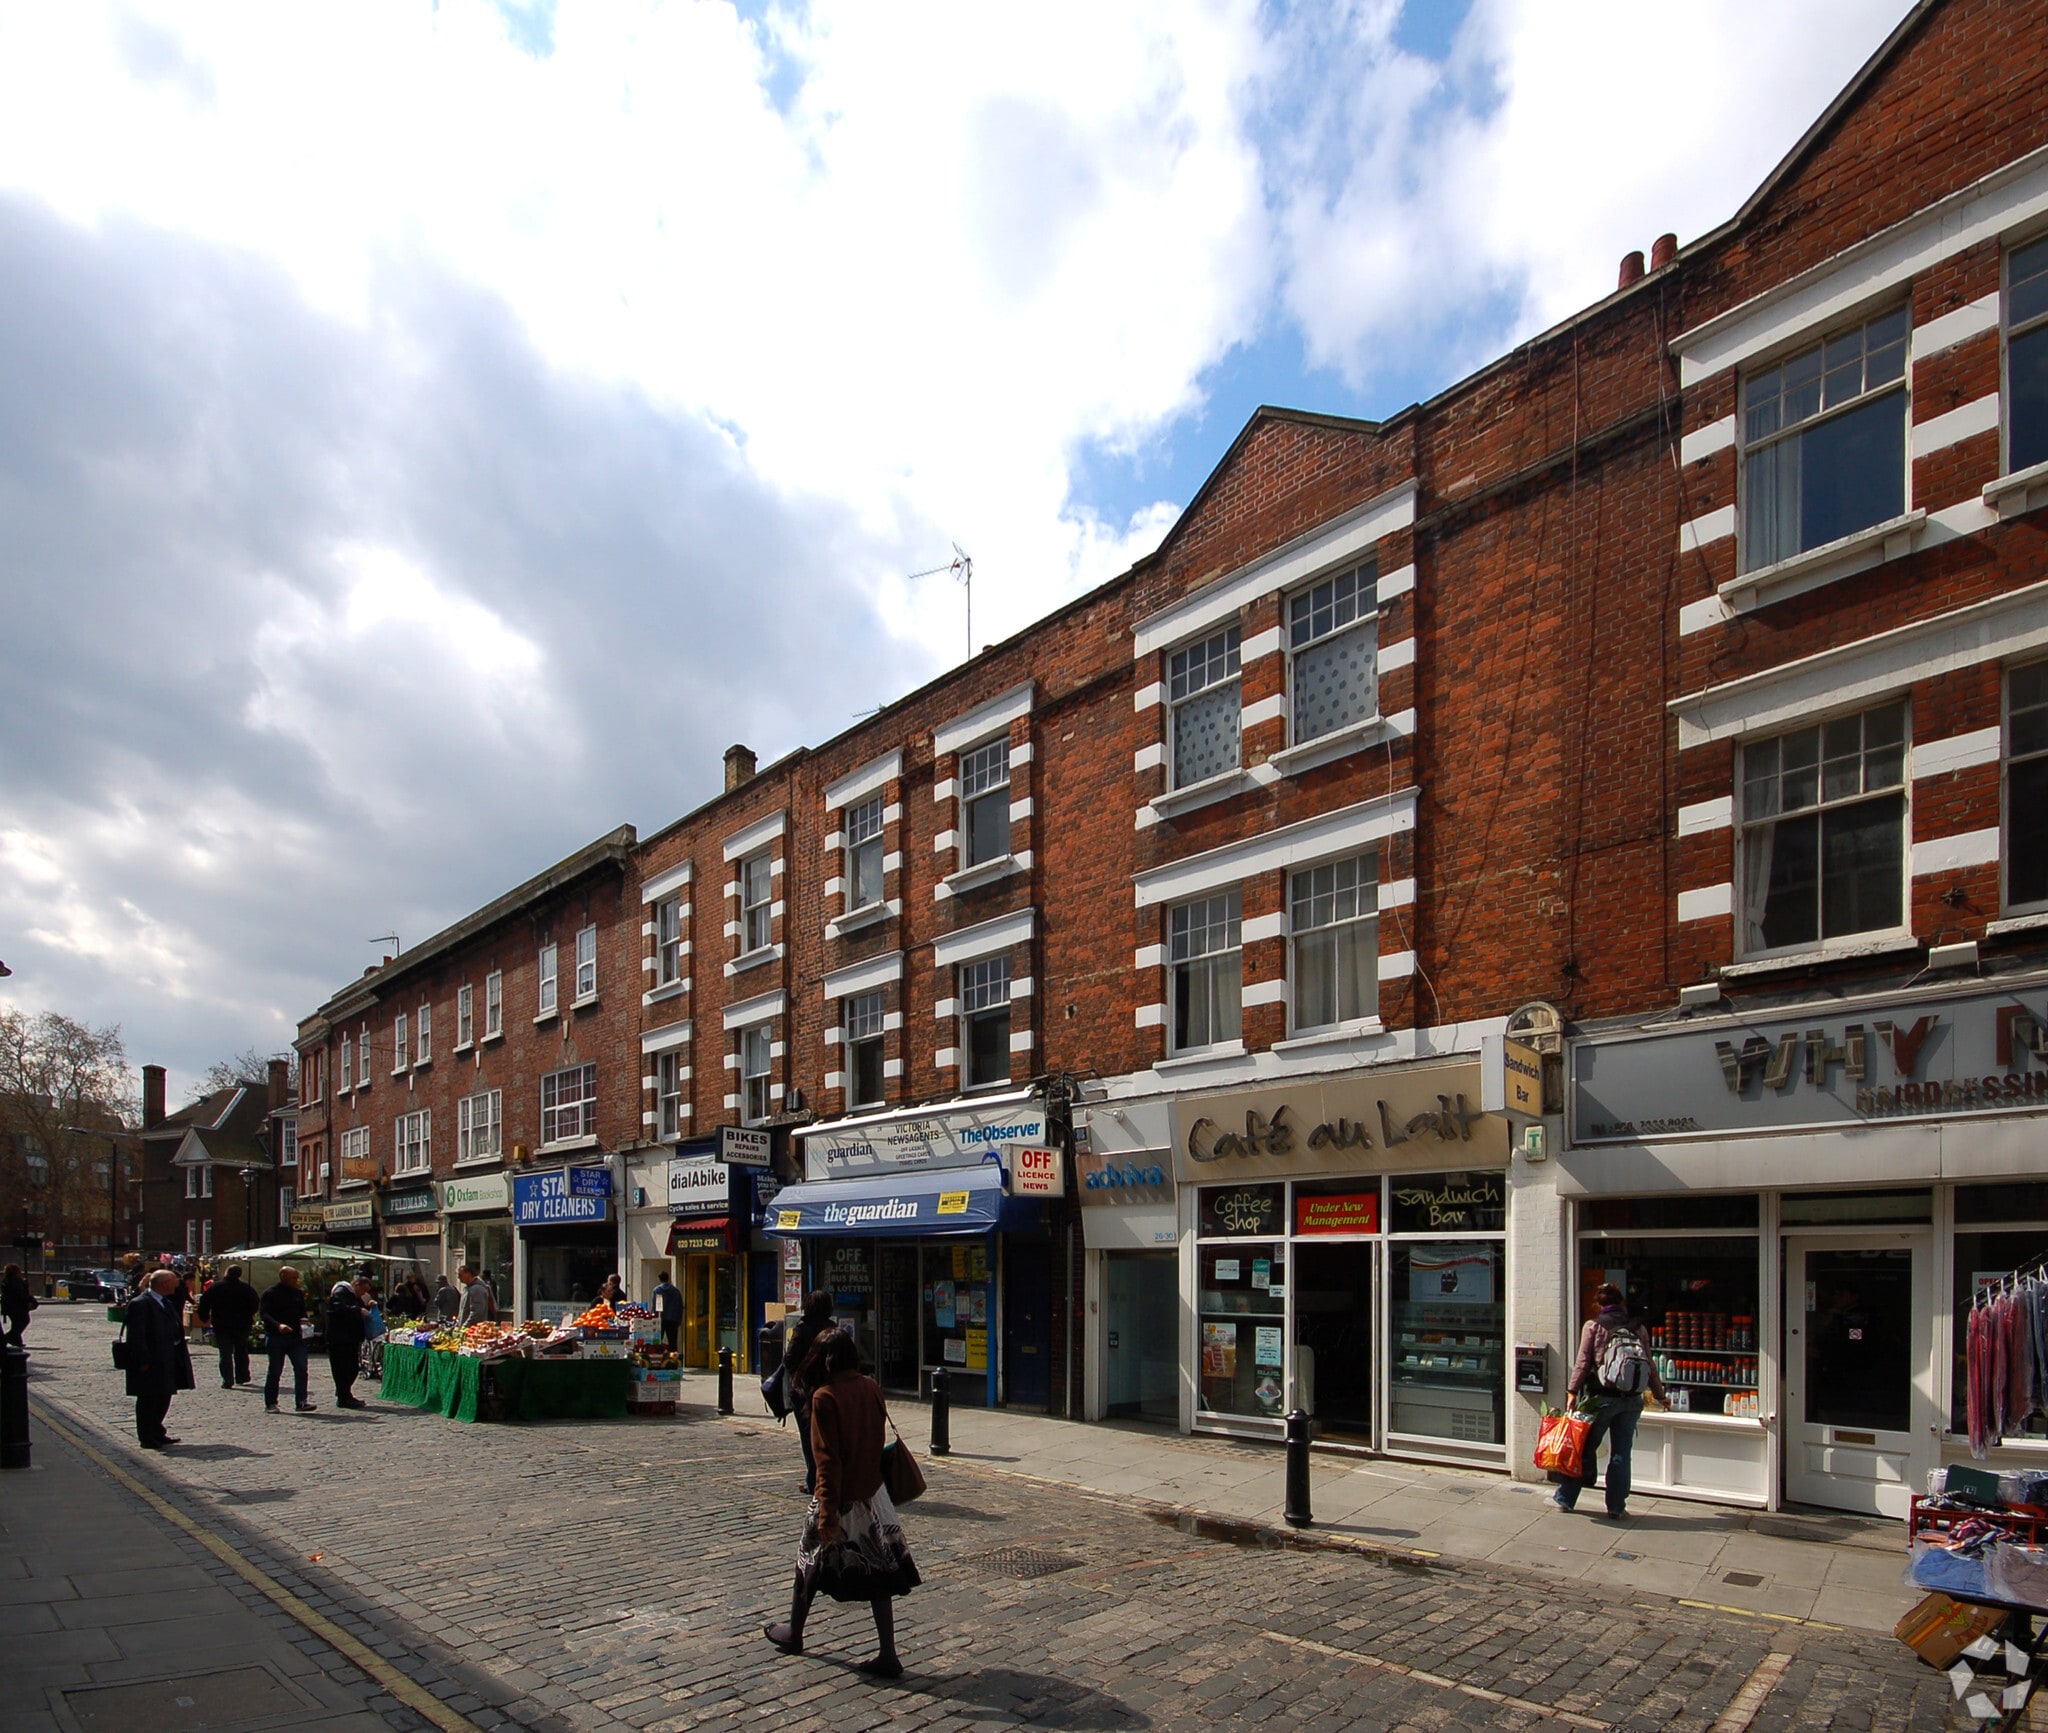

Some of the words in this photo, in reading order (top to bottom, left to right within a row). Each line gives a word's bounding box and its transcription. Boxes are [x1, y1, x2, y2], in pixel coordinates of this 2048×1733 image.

[1714, 1014, 1942, 1093] WHY
[1503, 1052, 1540, 1081] Sandwich
[1516, 1084, 1529, 1104] Bar
[894, 1120, 931, 1134] VICTORIA
[1188, 1104, 1295, 1163] Café
[1306, 1116, 1374, 1151] au
[1376, 1092, 1485, 1149] Lait
[726, 1131, 768, 1145] BIKES
[887, 1130, 940, 1146] NEWSAGENTS
[734, 1143, 760, 1152] REPAIRS
[726, 1151, 767, 1161] ACCESSORIES
[1021, 1150, 1052, 1169] OFF
[580, 1170, 601, 1179] STAR
[670, 1169, 727, 1190] dialAbike
[1017, 1171, 1056, 1180] LICENCE
[1085, 1161, 1163, 1190] adviva
[541, 1176, 565, 1197] STA
[582, 1178, 599, 1187] DRY
[1022, 1182, 1049, 1190] NEWS
[456, 1188, 479, 1202] Oxfam
[522, 1200, 541, 1220] DRY
[543, 1197, 596, 1218] CLEANERS
[668, 1204, 684, 1212] Cycle
[685, 1202, 700, 1211] sales
[706, 1201, 729, 1210] service
[1214, 1193, 1272, 1215] Coffee
[1309, 1202, 1341, 1213] Under
[1341, 1201, 1364, 1212] New
[1303, 1213, 1371, 1228] Management
[1429, 1205, 1466, 1226] Bar
[292, 1223, 321, 1232] OPEN
[677, 1240, 688, 1249] 020
[835, 1248, 862, 1262] OFF
[831, 1263, 868, 1273] LICENCE
[830, 1274, 847, 1282] BUS
[848, 1274, 870, 1283] PASS
[836, 1284, 873, 1293] LOTTERY
